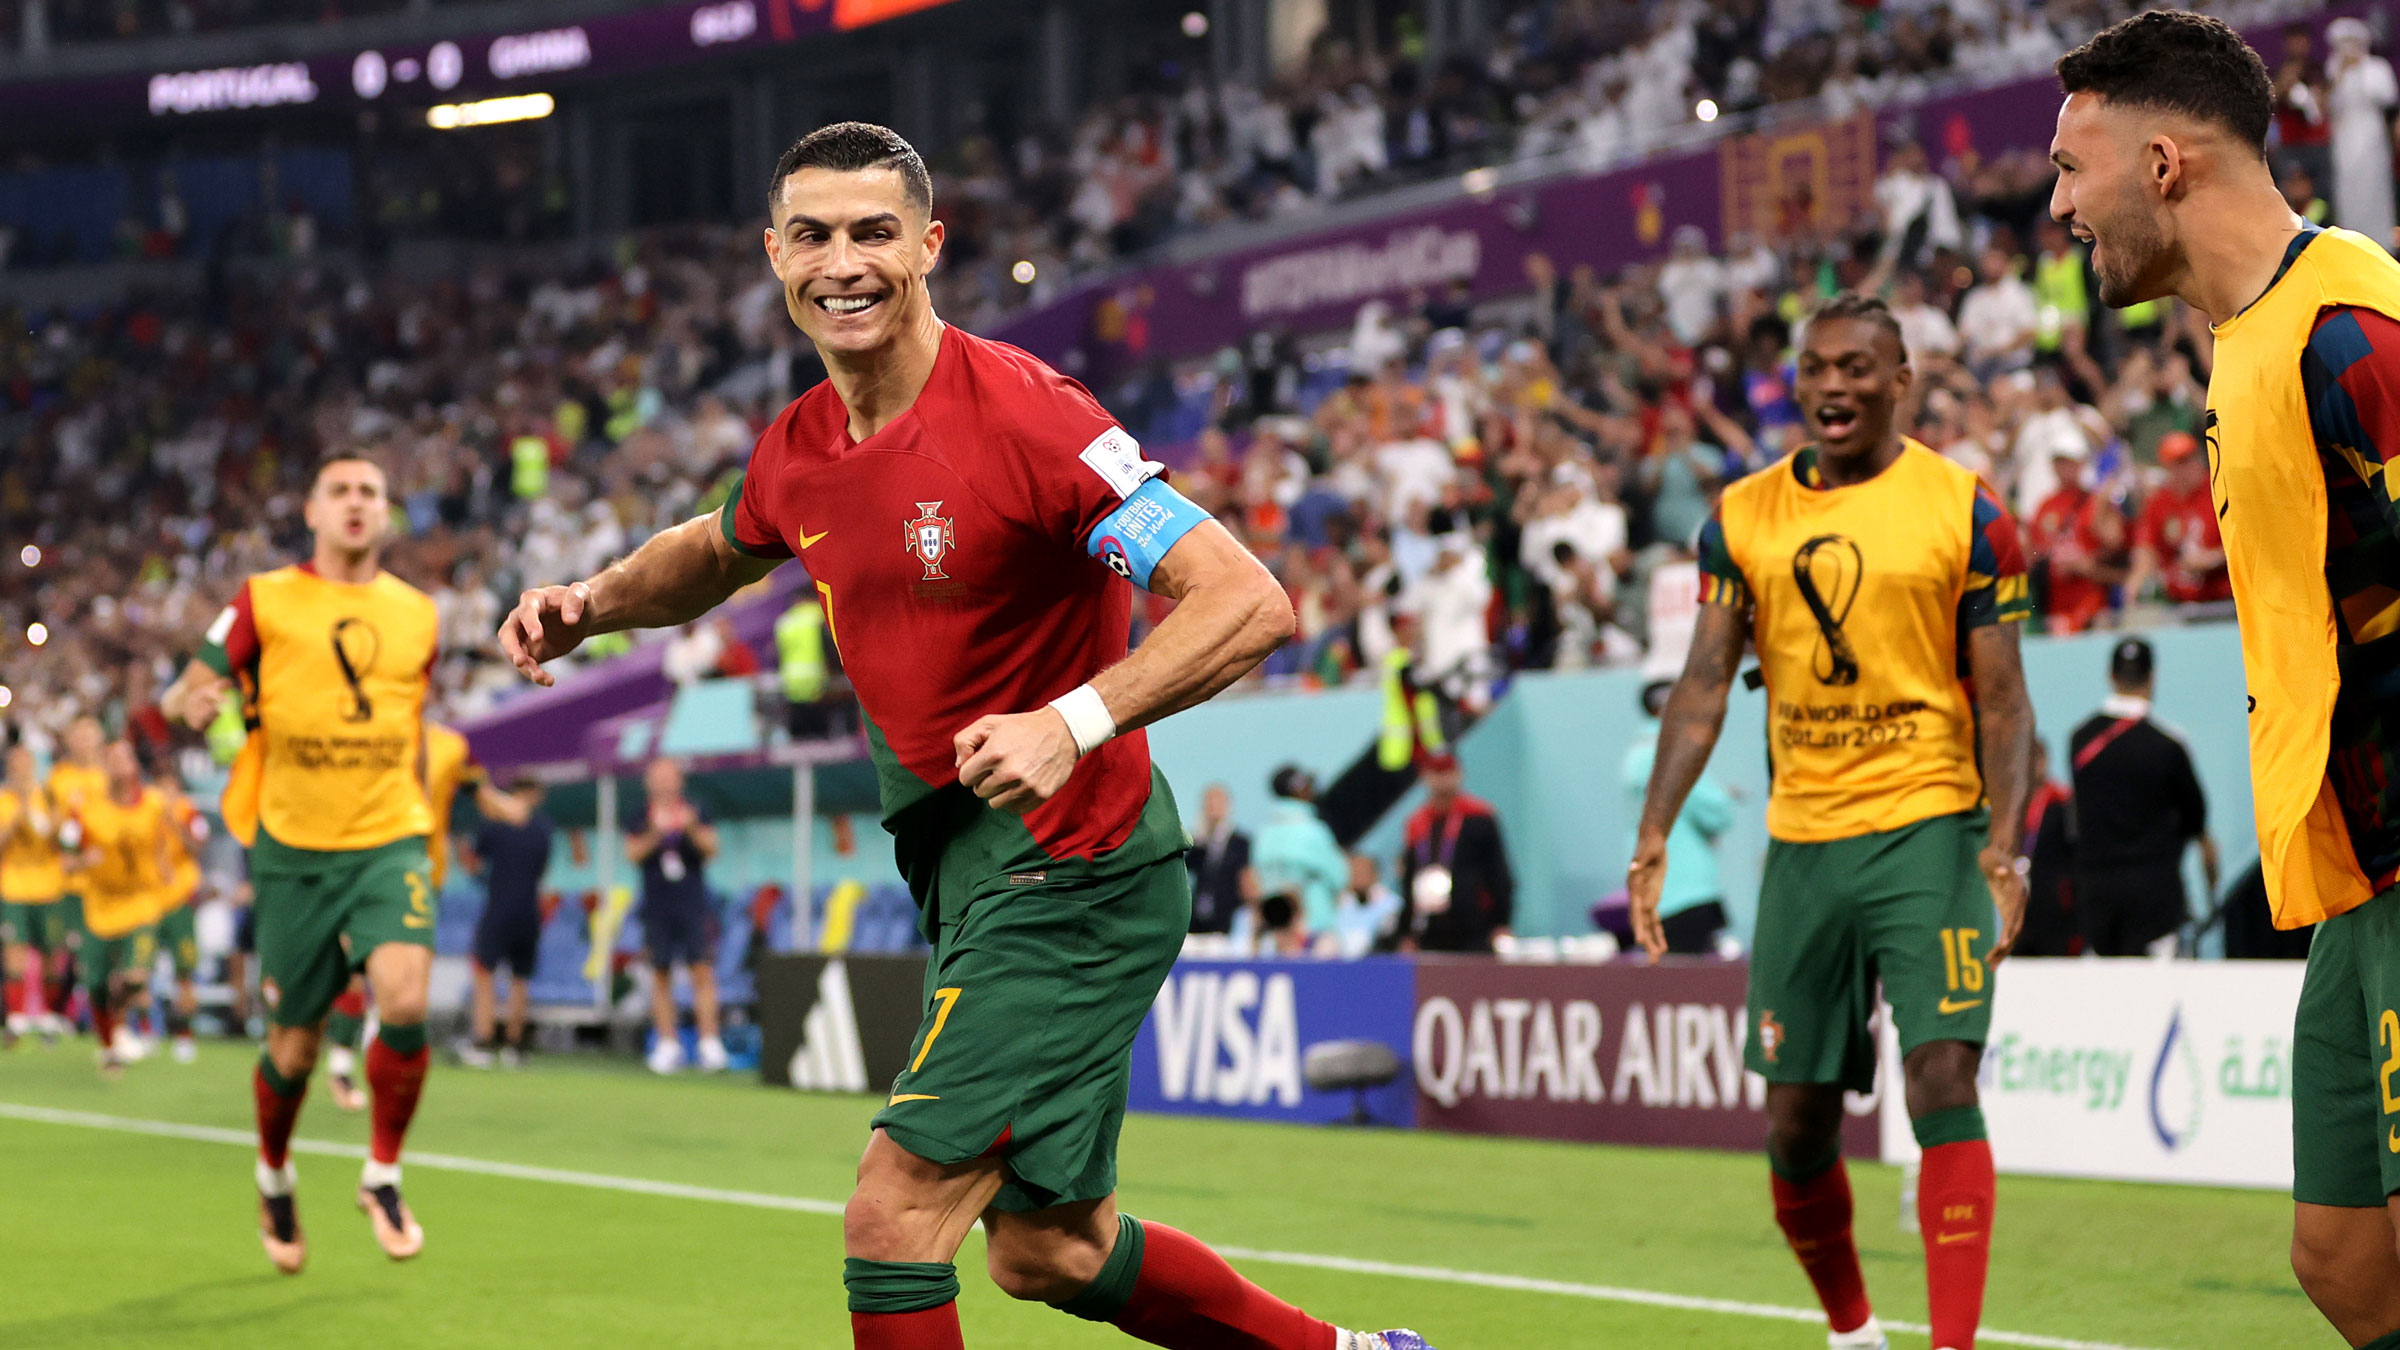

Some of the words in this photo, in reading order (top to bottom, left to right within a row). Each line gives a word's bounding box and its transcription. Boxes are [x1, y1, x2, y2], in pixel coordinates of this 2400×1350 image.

[149, 62, 318, 115] PORTUGAL
[352, 50, 387, 98] 0
[427, 40, 463, 90] 0
[1113, 495, 1152, 532] FOOTBALL
[1122, 500, 1163, 540] UNITES
[1147, 508, 1176, 535] World
[1806, 703, 1882, 723] WORLD
[1939, 928, 1985, 992] 15
[910, 987, 963, 1073] 7
[1153, 970, 1304, 1108] VISA
[1413, 995, 1606, 1109] QATAR
